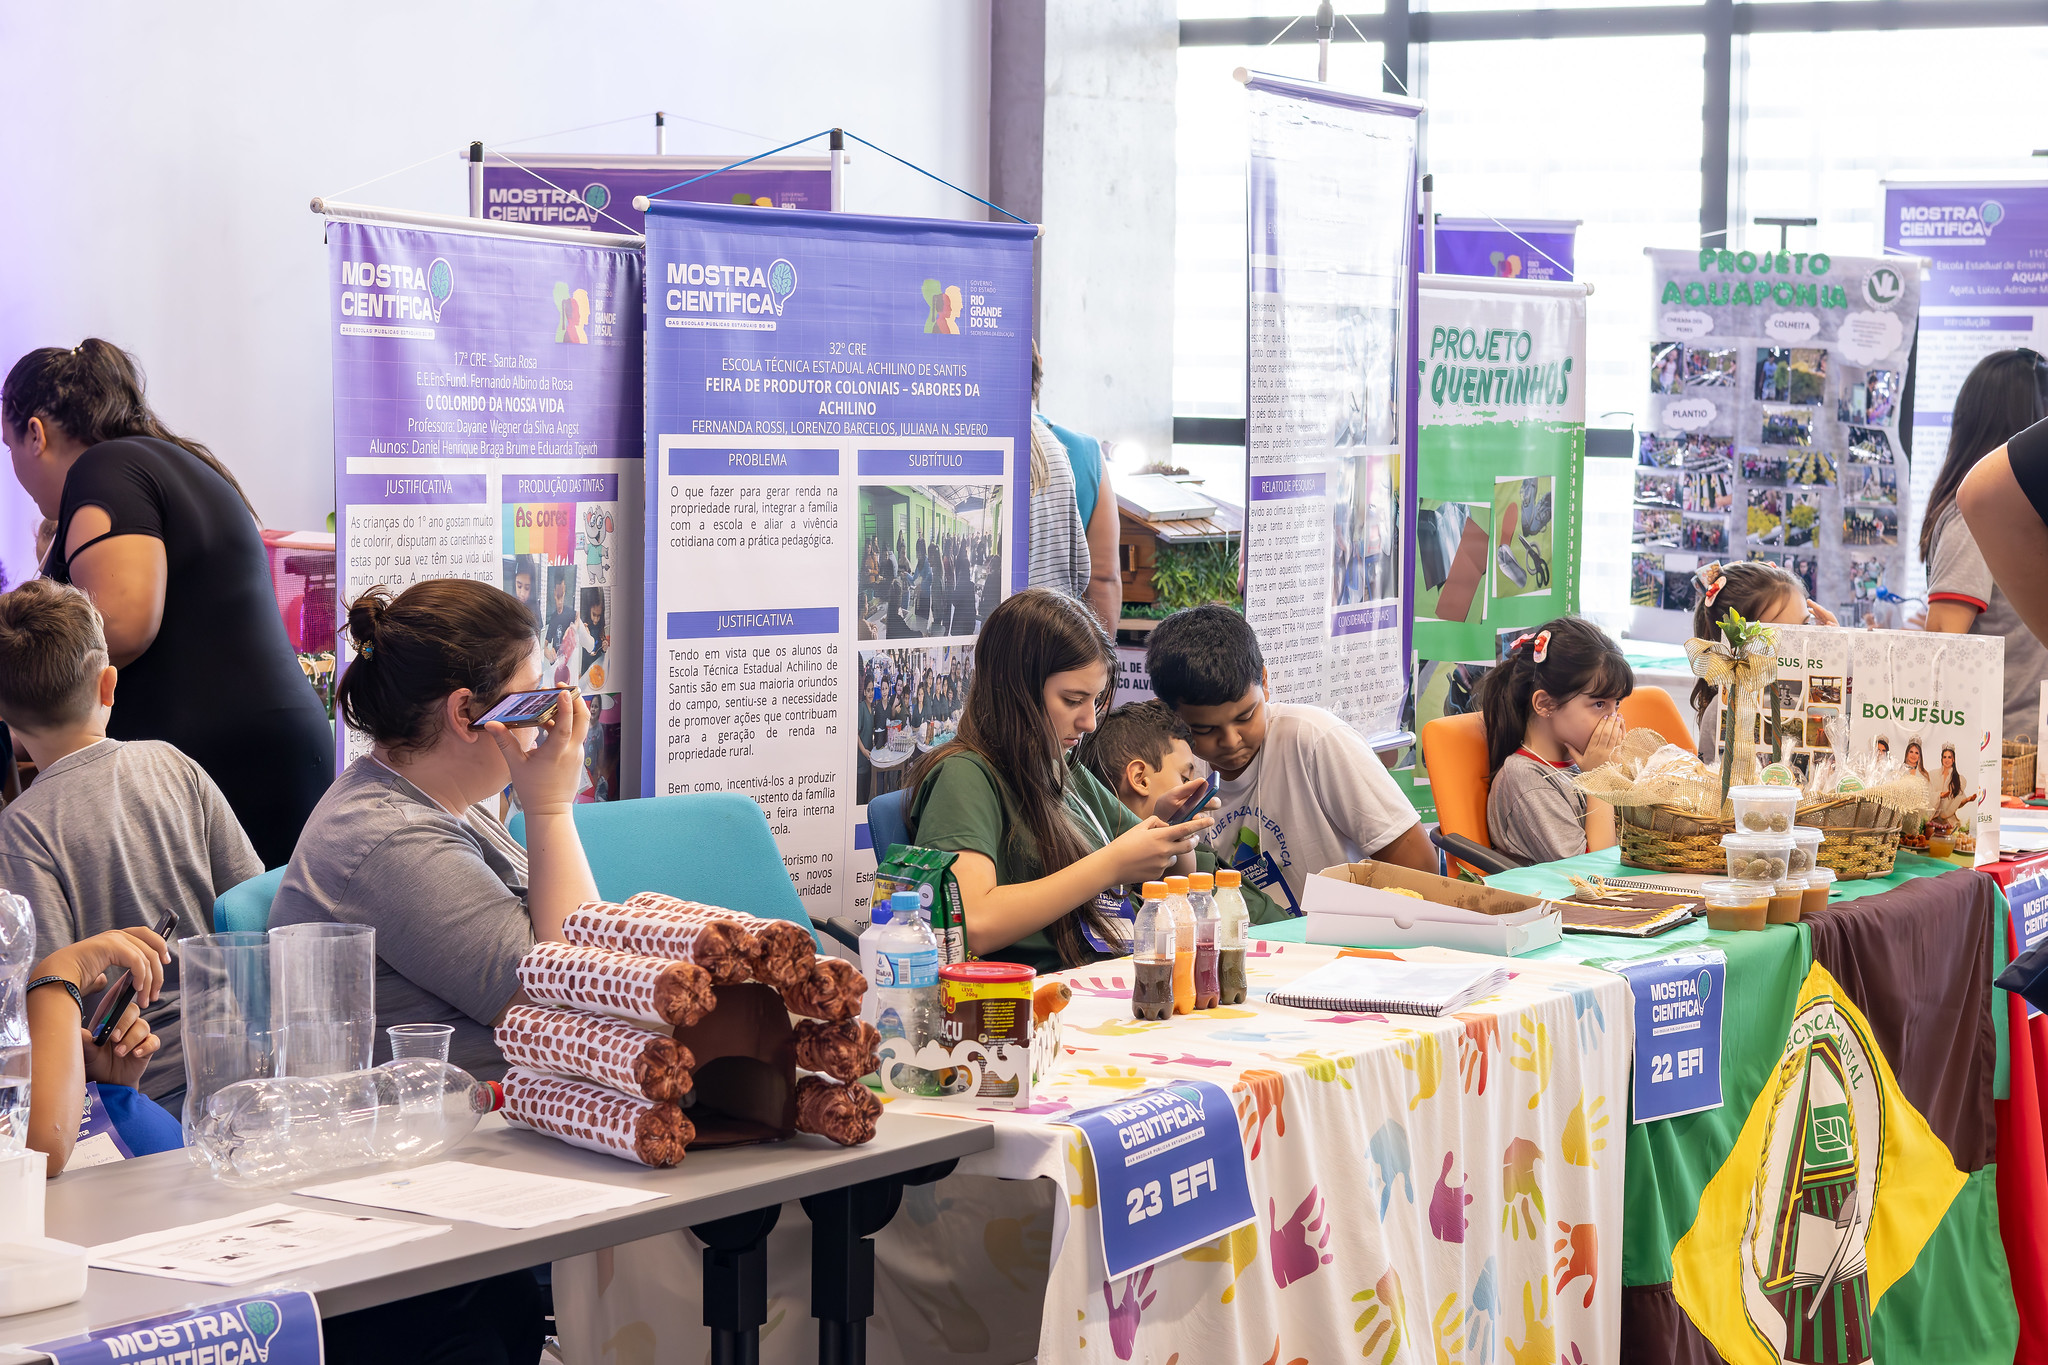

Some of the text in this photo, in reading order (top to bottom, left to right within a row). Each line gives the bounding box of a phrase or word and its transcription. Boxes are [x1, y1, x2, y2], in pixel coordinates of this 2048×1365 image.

[489, 188, 581, 204] MOSTRA
[489, 204, 589, 222] CIENTÍFICA
[1900, 206, 1979, 221] MOSTRA
[1900, 220, 1985, 237] CIENTÍFICA
[1699, 247, 1831, 276] PROJETO
[341, 260, 427, 291] MOSTRA
[666, 262, 767, 288] MOSTRA
[666, 287, 775, 315] CIENTÍFICA
[970, 294, 985, 306] RIO
[1661, 280, 1848, 309] AQUAPONIA
[341, 289, 433, 321] CIENTÍFICA
[970, 306, 1003, 318] GRANDE
[970, 317, 999, 329] DO SUL
[1774, 319, 1811, 331] COLHEITA
[828, 342, 867, 356] 32º CRE
[1430, 326, 1532, 362] PROJETO
[454, 352, 538, 369] 17ª CRE Santa Rosa
[722, 356, 968, 377] ESCOLA TÉCNICA ESTADUAL ACHILINO DE SANTIS
[416, 371, 574, 391] E.E.Ens.Fund. Fernando Albino da Rosa
[705, 377, 981, 397] FEIRA DE PRODUTOR COLONIAIS SABORES DA
[1431, 357, 1574, 409] QUENTINHOS
[425, 394, 565, 413] O COLORIDO DA NOSSA VIDA
[818, 400, 877, 416] ACHILINO
[1672, 408, 1708, 419] PLANTIO
[408, 417, 580, 438] Professora: Dayane Wegner da Silva Angst
[692, 419, 989, 438] FERNANDA ROSSI, LORENZO BARCELOS, JULIANA N. SEVERO
[369, 438, 573, 458] Alunos: Daniel Henrique Braga Brum e Eduarda
[728, 453, 788, 467] PROBLEMA
[908, 451, 963, 467] SUBTÍTULO
[384, 479, 454, 498] JUSTIFICATIVA
[518, 476, 605, 497] PRODUÇÃO DAS TINTAS
[670, 485, 838, 500] O que fazer para gerar renda na
[1261, 480, 1284, 493] RELATO
[1284, 480, 1291, 492] DE
[515, 506, 568, 528] As cores
[670, 500, 838, 517] propriedade rural, integrar a família
[350, 516, 361, 529] As
[363, 515, 400, 532] crianças
[402, 515, 415, 529] do
[428, 517, 444, 528] ano
[445, 516, 471, 532] gostam
[472, 514, 494, 527] muito
[670, 517, 838, 531] com a escola e aliar a vivência
[670, 534, 834, 549] cotidiana com a prática pedagógica.
[716, 613, 795, 632] JUSTIFICATIVA
[669, 642, 838, 661] Tendo em vista que os alunos da
[1130, 662, 1142, 674] DE
[1776, 656, 1823, 671] SUS, RS
[1862, 703, 1965, 727] BOM JESUS
[1977, 814, 1993, 823] ESUS
[1254, 806, 1292, 868] DERENÇA
[949, 882, 962, 915] inuano
[1650, 979, 1697, 1001] MOSTRA
[1652, 997, 1700, 1023] CIENTÍFICA
[1651, 1047, 1703, 1084] 22 EFI
[1837, 1032, 1864, 1090] ADUAL
[1101, 1090, 1182, 1126] MOSTRA
[1118, 1103, 1200, 1150] CIENTÍFICA
[1126, 1158, 1217, 1225] 23 EFI
[103, 1311, 244, 1359] MOSTRA
[120, 1338, 257, 1365] TÍFICA
